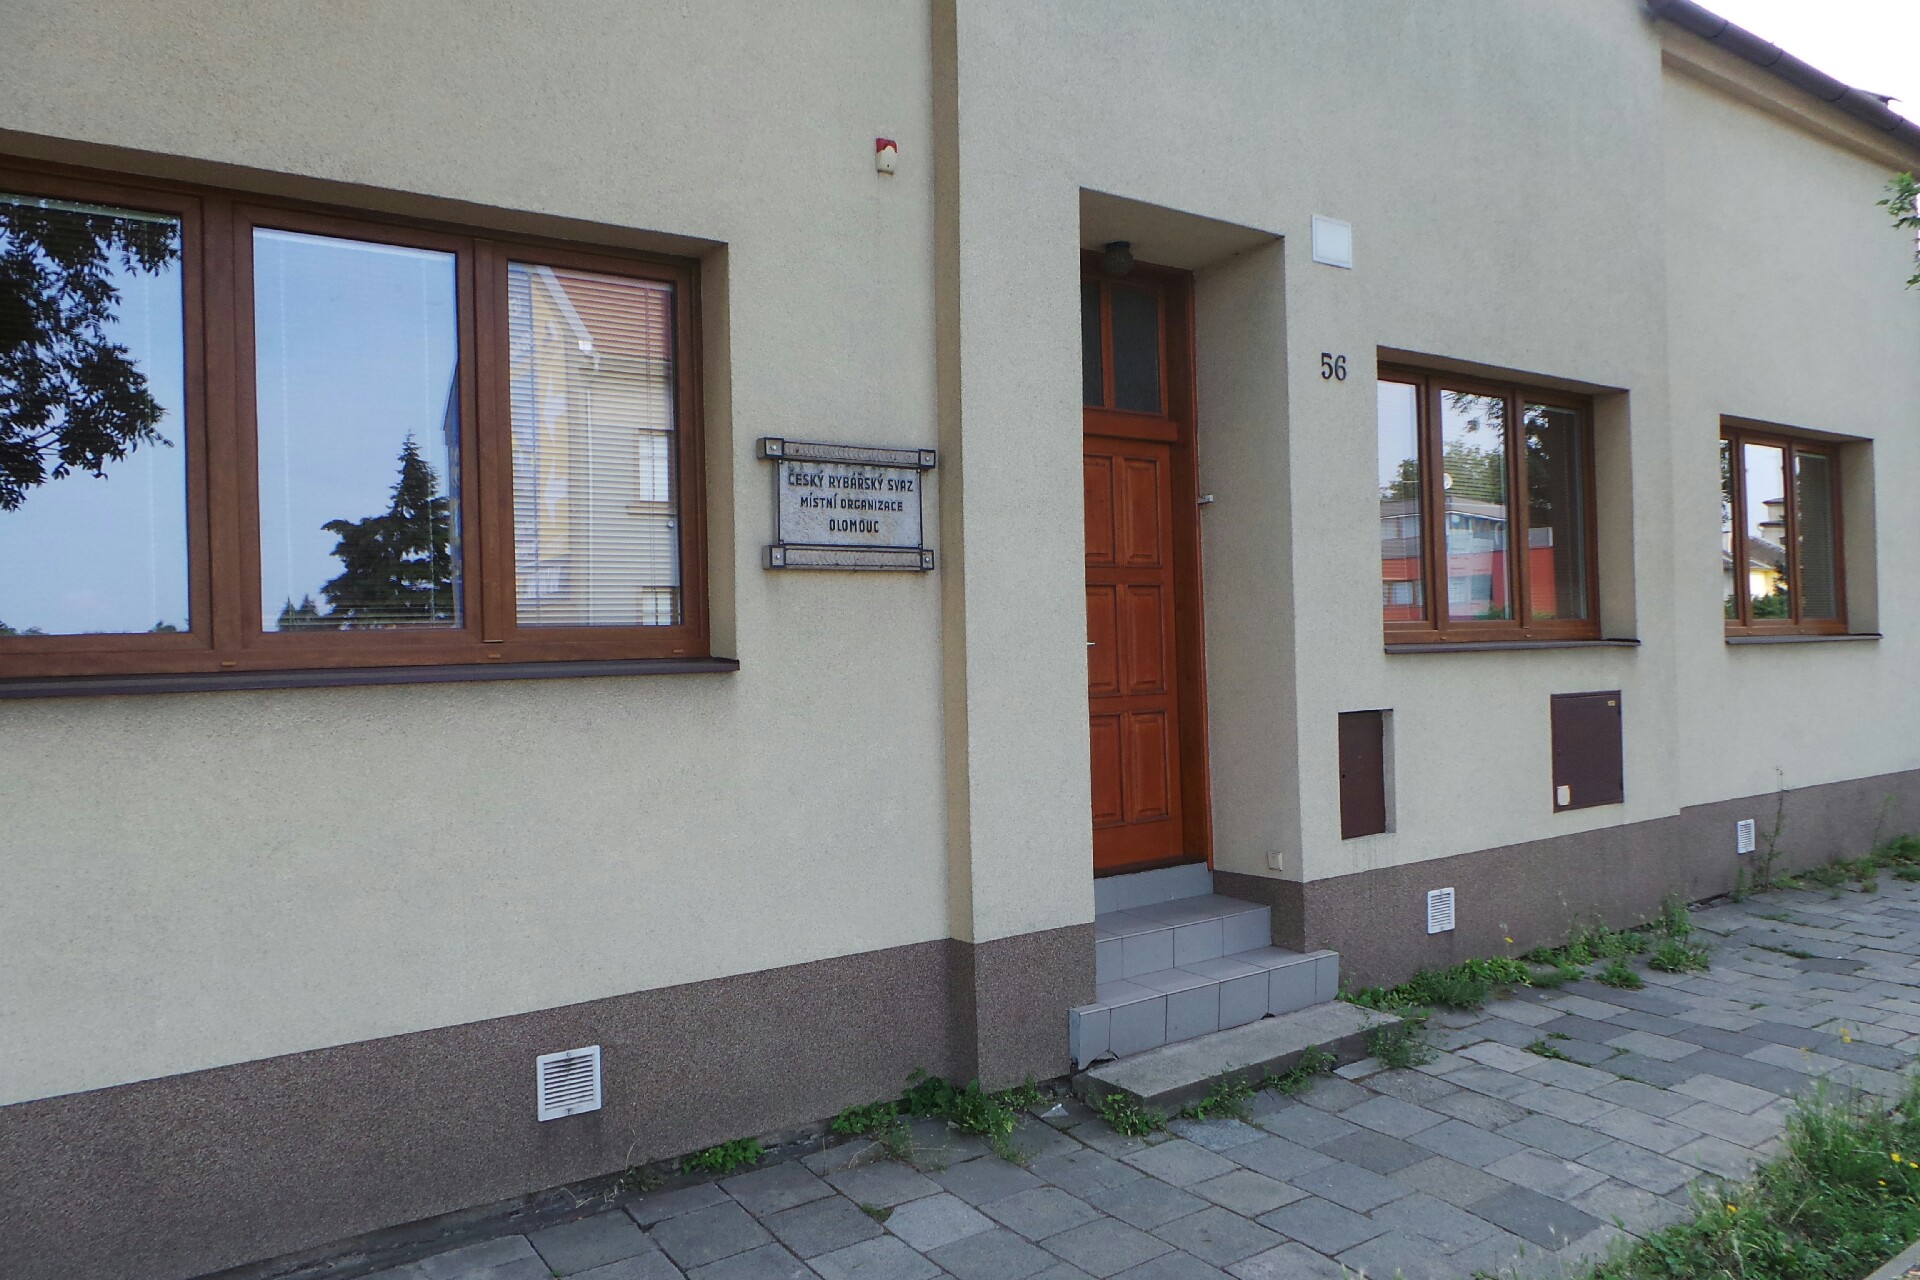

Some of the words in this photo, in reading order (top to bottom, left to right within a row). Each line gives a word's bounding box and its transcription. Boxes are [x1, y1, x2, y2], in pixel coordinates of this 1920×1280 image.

[1321, 352, 1347, 381] 56
[788, 470, 824, 487] ČESKÝ
[828, 472, 884, 491] RYBÁŘSKÝ
[888, 479, 914, 492] SVAZ
[800, 492, 837, 509] MÍSTNÍ
[840, 498, 903, 512] ORGANIZACE
[829, 518, 879, 533] OLOMOUC
